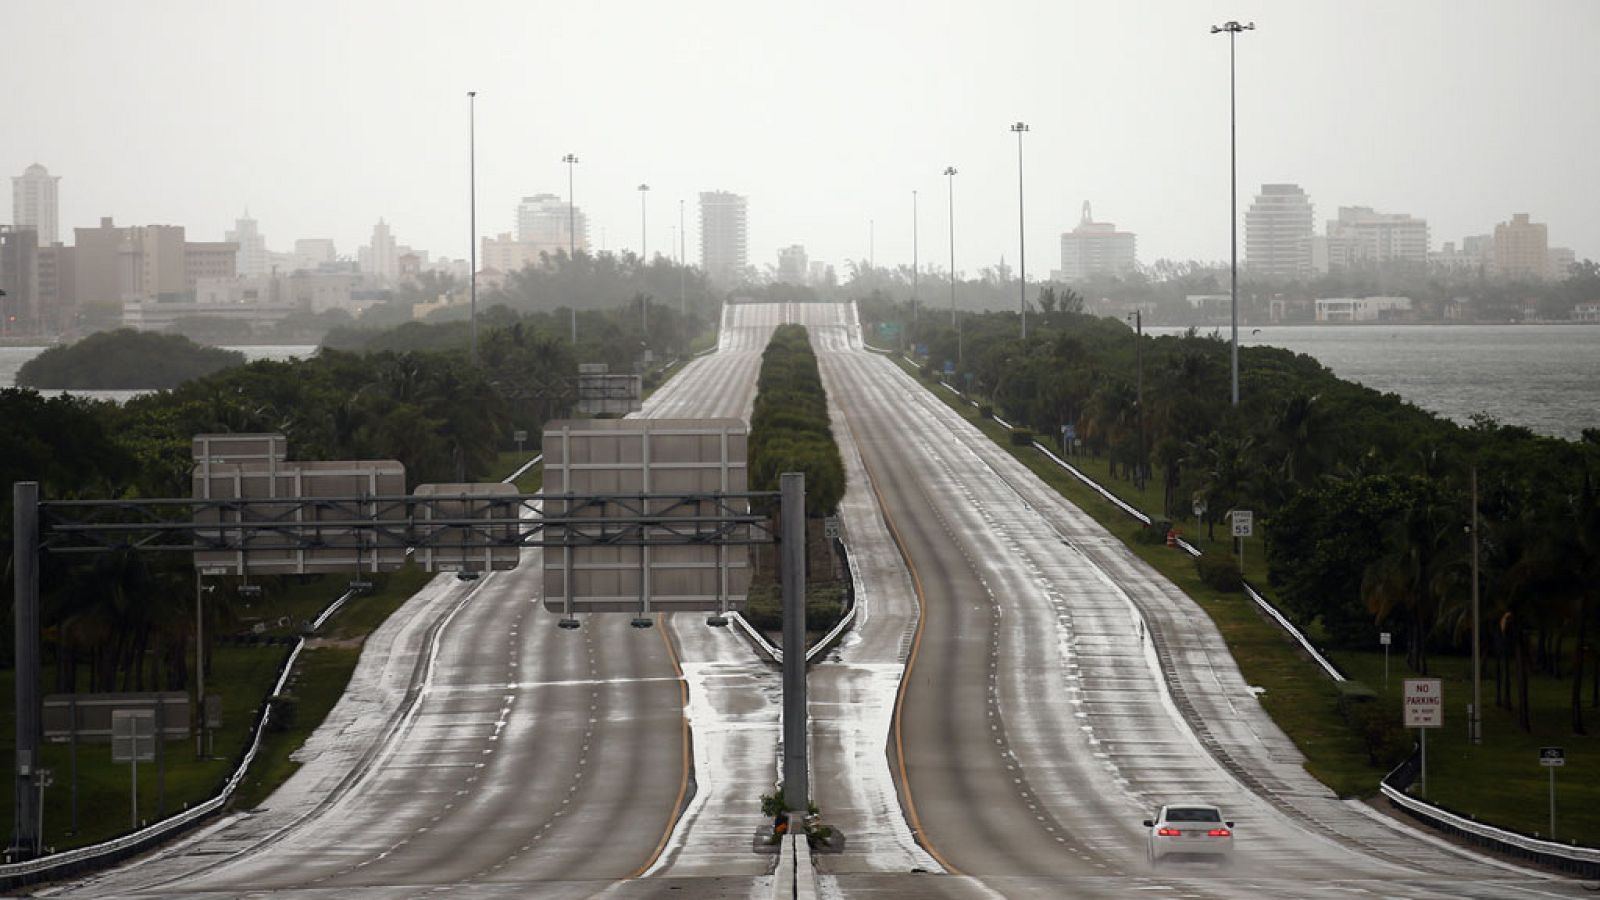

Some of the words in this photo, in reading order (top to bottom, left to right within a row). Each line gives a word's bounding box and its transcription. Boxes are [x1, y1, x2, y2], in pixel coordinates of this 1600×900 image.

[1235, 525, 1249, 534] 55
[1416, 684, 1429, 693] NO
[1407, 696, 1440, 705] PARKING
